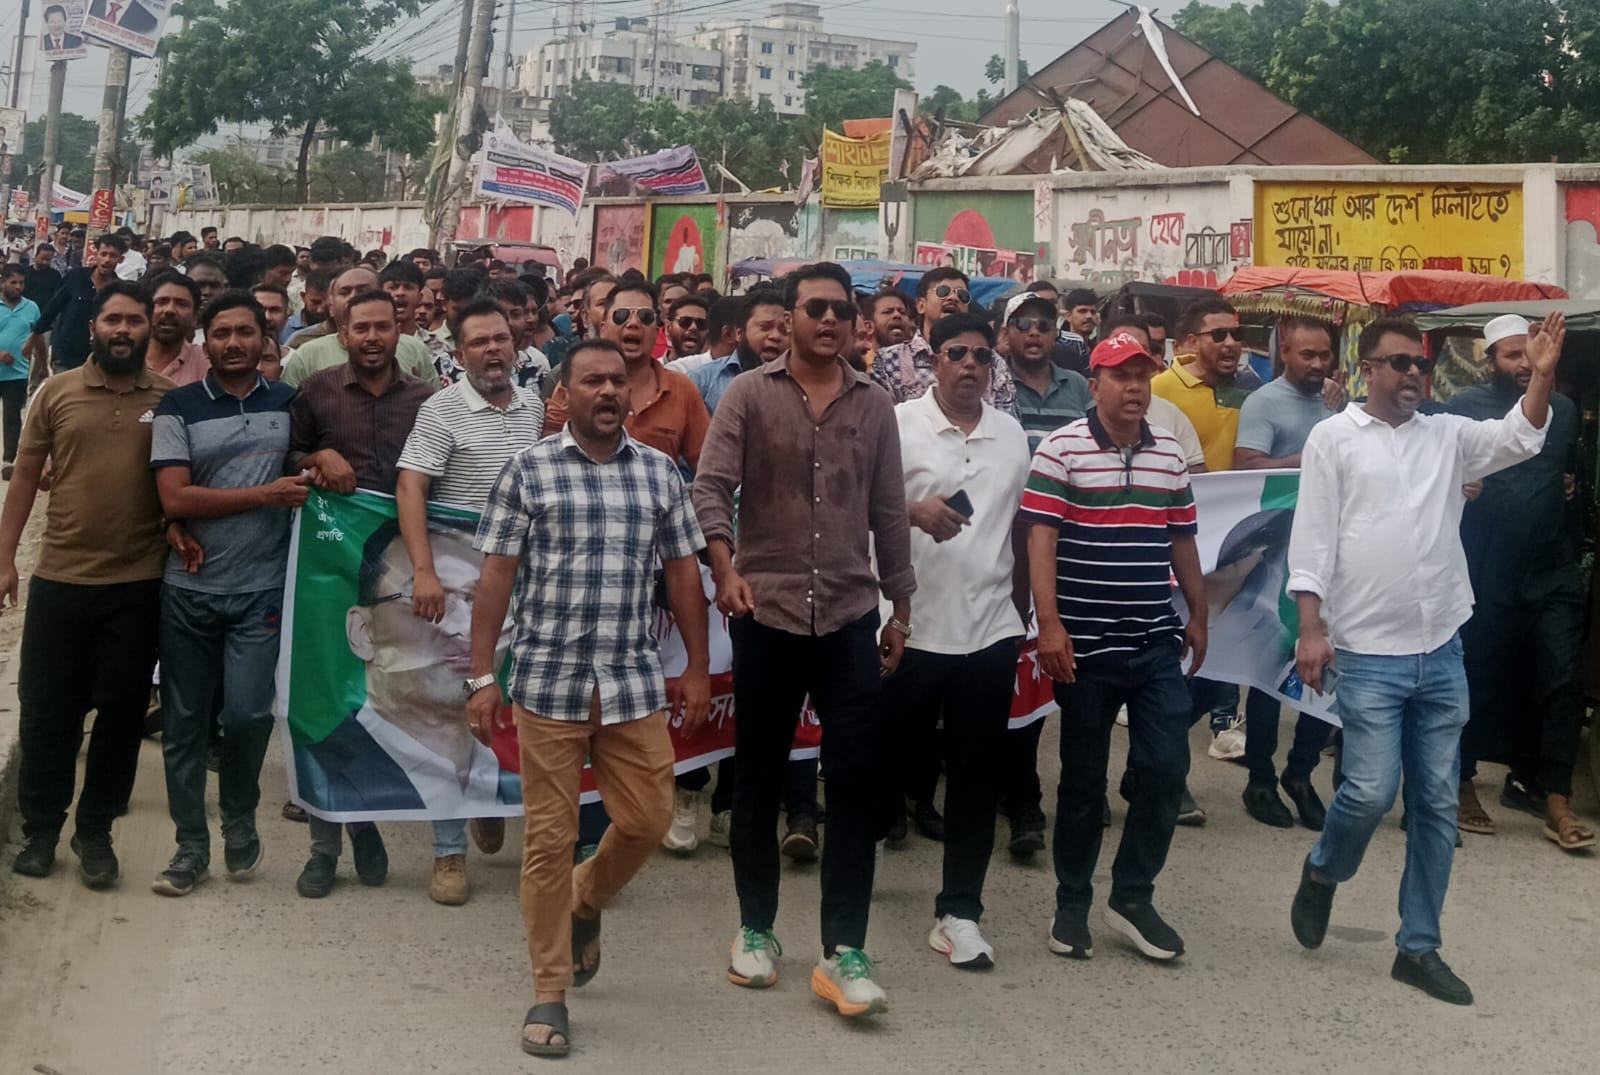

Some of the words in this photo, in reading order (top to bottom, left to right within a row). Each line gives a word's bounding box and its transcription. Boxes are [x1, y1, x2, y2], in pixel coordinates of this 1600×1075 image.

[1313, 189, 1338, 216] ধর্ম
[1343, 193, 1380, 221] আর
[1386, 192, 1424, 225] দেশ
[1150, 213, 1185, 246] হোক
[316, 528, 344, 541] প্রগতি
